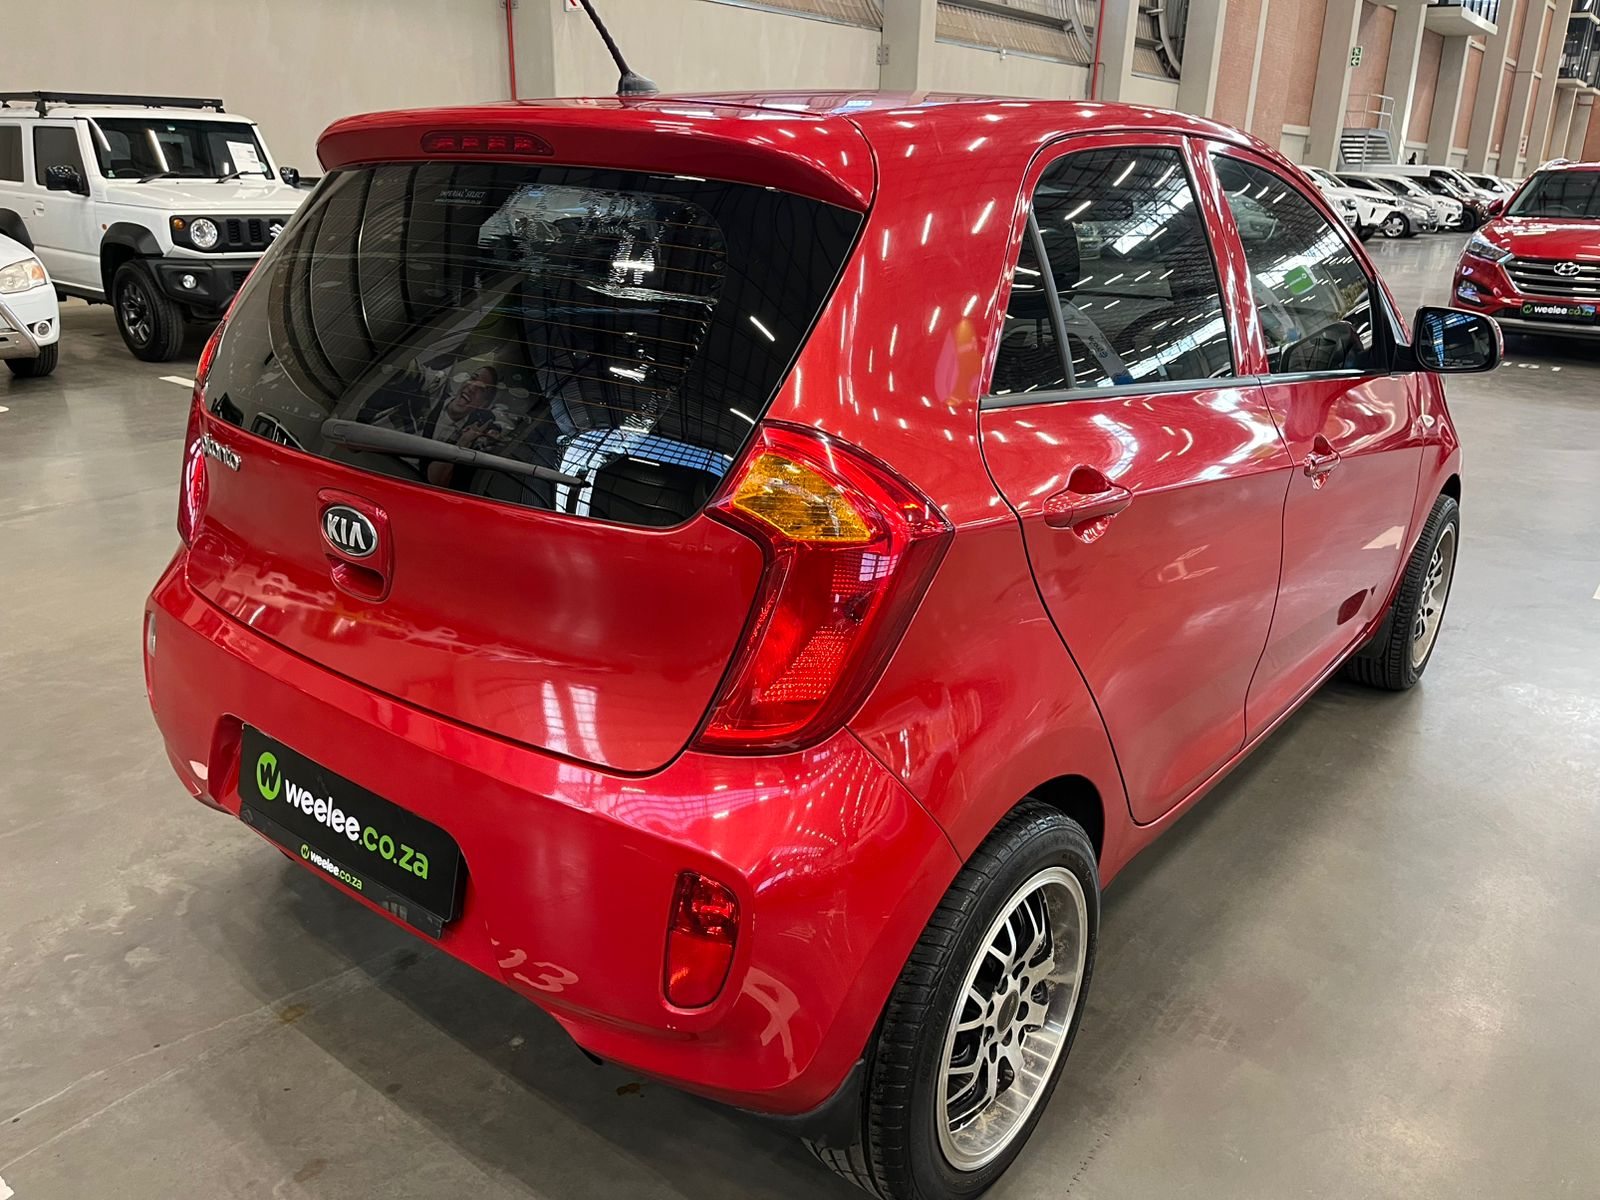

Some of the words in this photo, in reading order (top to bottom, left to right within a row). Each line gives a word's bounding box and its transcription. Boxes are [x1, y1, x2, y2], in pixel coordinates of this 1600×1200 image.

[327, 513, 367, 551] KIA
[284, 778, 429, 880] weelee.co.za
[310, 850, 363, 890] weelee.co.za
